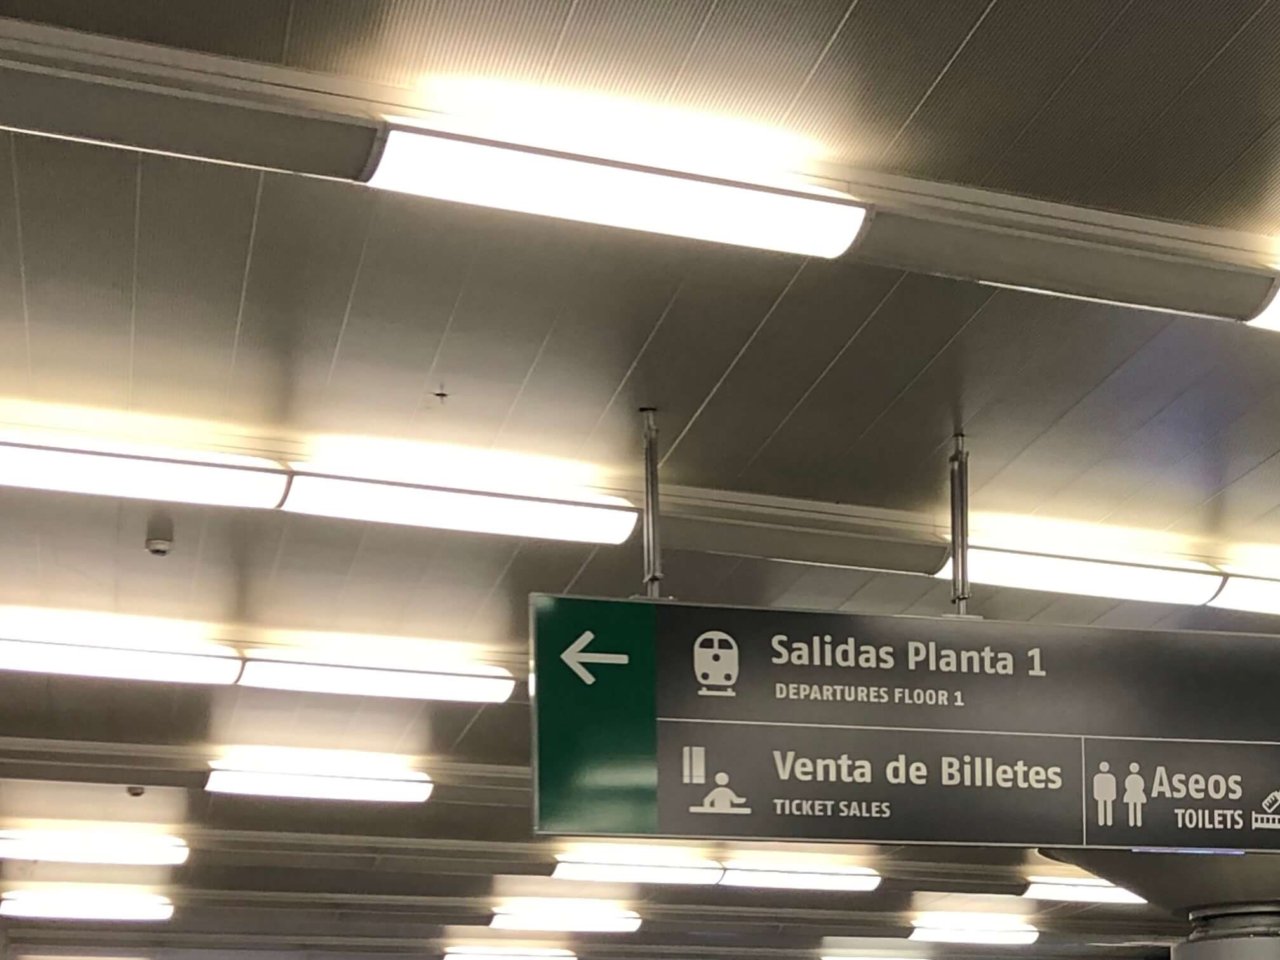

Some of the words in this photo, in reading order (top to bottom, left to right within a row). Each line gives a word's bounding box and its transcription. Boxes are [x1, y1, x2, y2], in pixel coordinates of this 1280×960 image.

[771, 634, 895, 669] Salidas
[907, 641, 1014, 675] Planta
[1027, 647, 1047, 677] 1
[775, 683, 889, 703] DEPARTURES
[894, 688, 949, 706] FLOOR
[954, 690, 965, 707] 1
[772, 750, 873, 783] Venta
[885, 754, 928, 785] de
[941, 755, 1063, 790] Billetes
[1150, 766, 1243, 800] Aseos
[772, 798, 835, 816] TICKET
[838, 800, 891, 818] SALES
[1174, 808, 1244, 830] TOILETS
